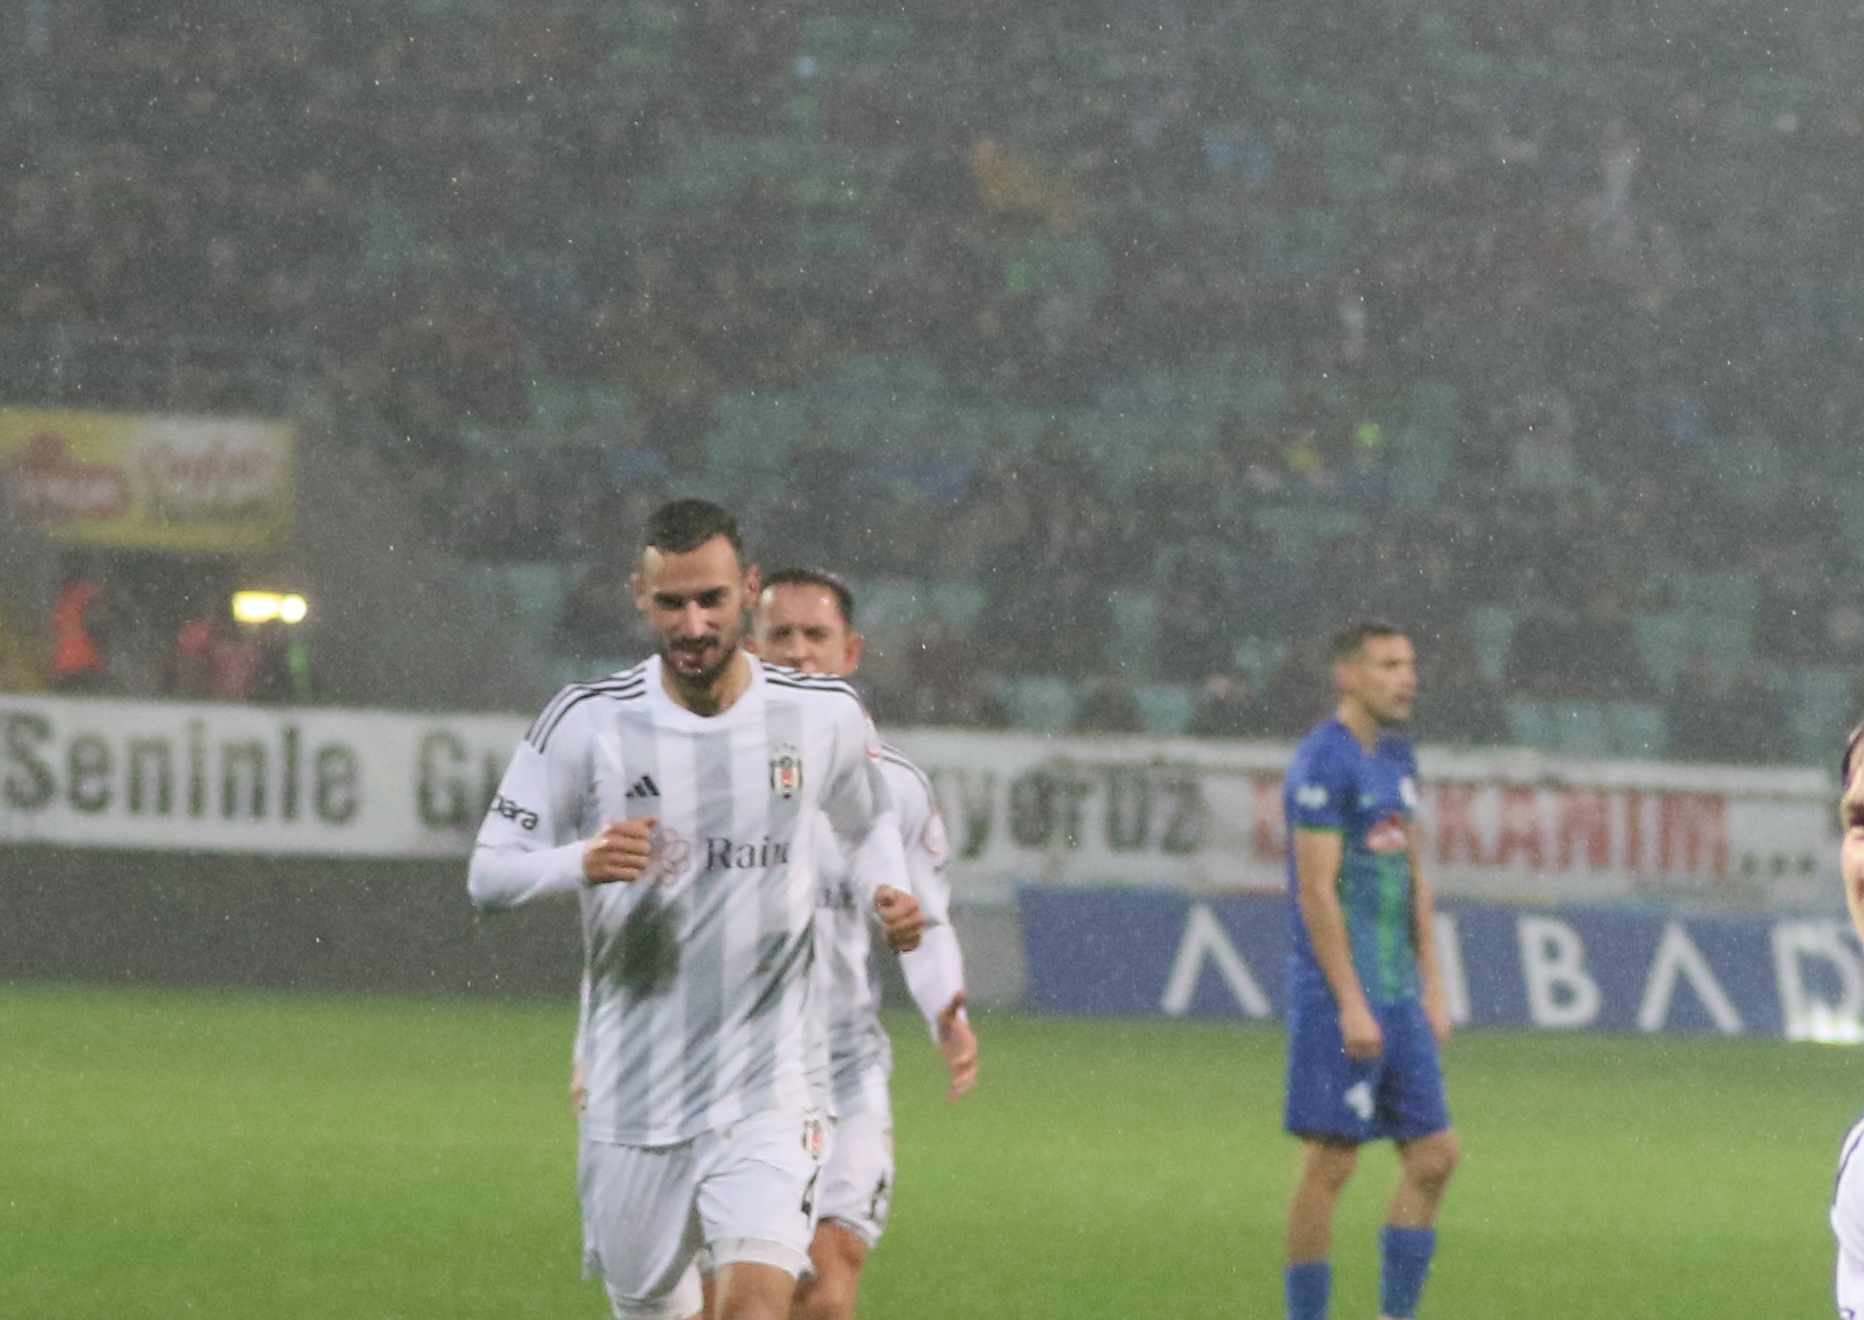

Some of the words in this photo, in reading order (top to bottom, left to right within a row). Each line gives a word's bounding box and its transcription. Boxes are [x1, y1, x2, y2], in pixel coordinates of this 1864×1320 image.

[2, 711, 361, 827] Seninle
[930, 763, 1203, 860] yoruz
[705, 835, 789, 870] Rain
